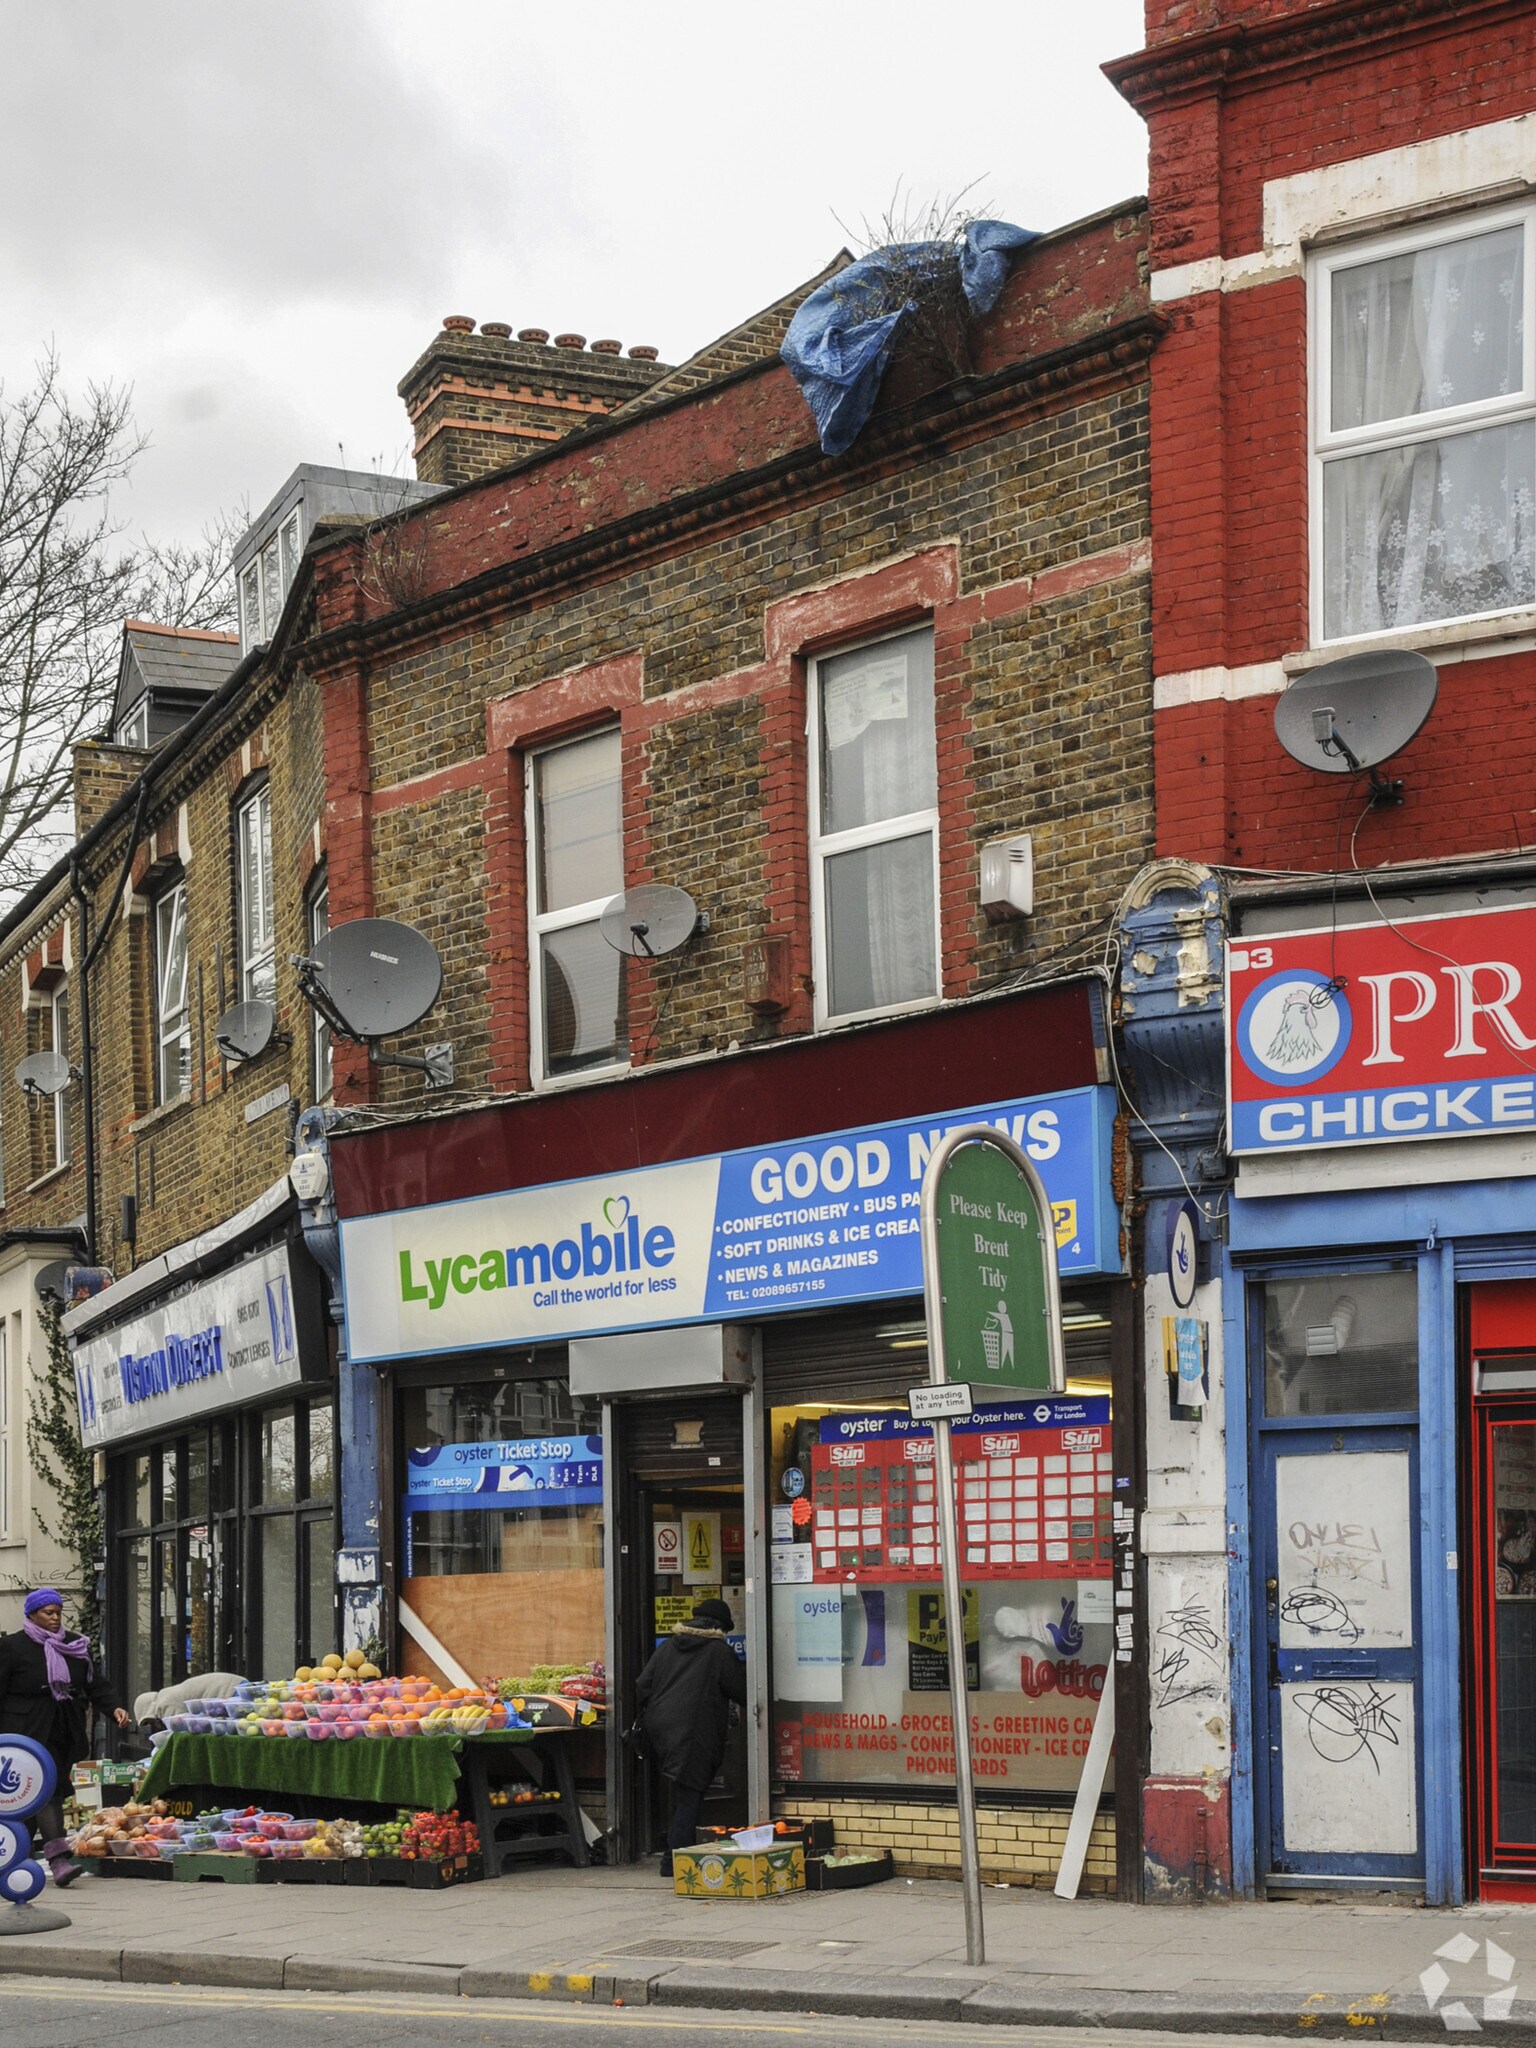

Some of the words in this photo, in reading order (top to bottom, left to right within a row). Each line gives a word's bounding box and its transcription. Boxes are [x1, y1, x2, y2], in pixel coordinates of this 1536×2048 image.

[1358, 961, 1536, 1066] PR
[1259, 1081, 1535, 1142] CHICKE
[751, 1139, 891, 1204] GOOD
[908, 1110, 1061, 1180] NS
[722, 1202, 850, 1235] CONFECTIONERY
[864, 1195, 897, 1214] BUS
[901, 1191, 921, 1208] PA
[950, 1193, 992, 1220] Please
[996, 1201, 1028, 1229] Keep
[724, 1240, 763, 1260] SOFT
[767, 1232, 825, 1254] DRINKS
[828, 1229, 840, 1245] &
[843, 1225, 871, 1242] ICE
[875, 1218, 921, 1239] CREA
[973, 1233, 1010, 1258] Brent
[400, 1212, 676, 1310] Lycamobile
[725, 1265, 768, 1284] NEWS
[772, 1262, 783, 1278] &
[787, 1249, 879, 1277] MAGAZINES
[726, 1289, 749, 1302] TEL:
[752, 1279, 826, 1299] 02089657155
[979, 1265, 1008, 1292] Tidy
[533, 1289, 559, 1307] Call
[560, 1287, 583, 1304] the
[584, 1281, 622, 1300] world
[624, 1280, 645, 1296] for
[648, 1277, 678, 1294] less
[165, 1325, 223, 1388] DIRECT
[915, 1402, 926, 1410] at
[927, 1401, 943, 1410] any
[945, 1398, 965, 1407] time
[916, 1394, 928, 1402] No
[931, 1390, 963, 1402] loading
[1054, 1404, 1083, 1412] Transport
[840, 1417, 884, 1438] oyster
[893, 1420, 909, 1431] Buy
[951, 1415, 970, 1427] your
[972, 1412, 1002, 1425] Oyster
[1004, 1411, 1026, 1421] here.
[1054, 1412, 1064, 1420] for
[1064, 1411, 1087, 1420] London
[983, 1436, 1018, 1451] Sun
[1064, 1430, 1100, 1445] Sun
[1332, 1433, 1345, 1450] 3
[455, 1447, 493, 1465] oyster
[497, 1443, 538, 1460] Ticket
[540, 1441, 573, 1460] Stop
[832, 1445, 864, 1461] Sun
[409, 1479, 431, 1489] oyster
[432, 1478, 454, 1488] Ticket
[455, 1476, 472, 1489] Stop
[803, 1599, 848, 1617] oyster
[1021, 1655, 1108, 1702] Lotto
[803, 1712, 888, 1730] HOUSEHOLD
[901, 1714, 979, 1732] GROCES
[993, 1715, 1070, 1735] GREETING
[1073, 1716, 1093, 1735] CA
[803, 1733, 841, 1750] NEWS
[844, 1734, 853, 1749] &
[857, 1734, 898, 1751] MAGS
[1045, 1738, 1068, 1756] ICE
[906, 1755, 1009, 1776] PHONEARDS
